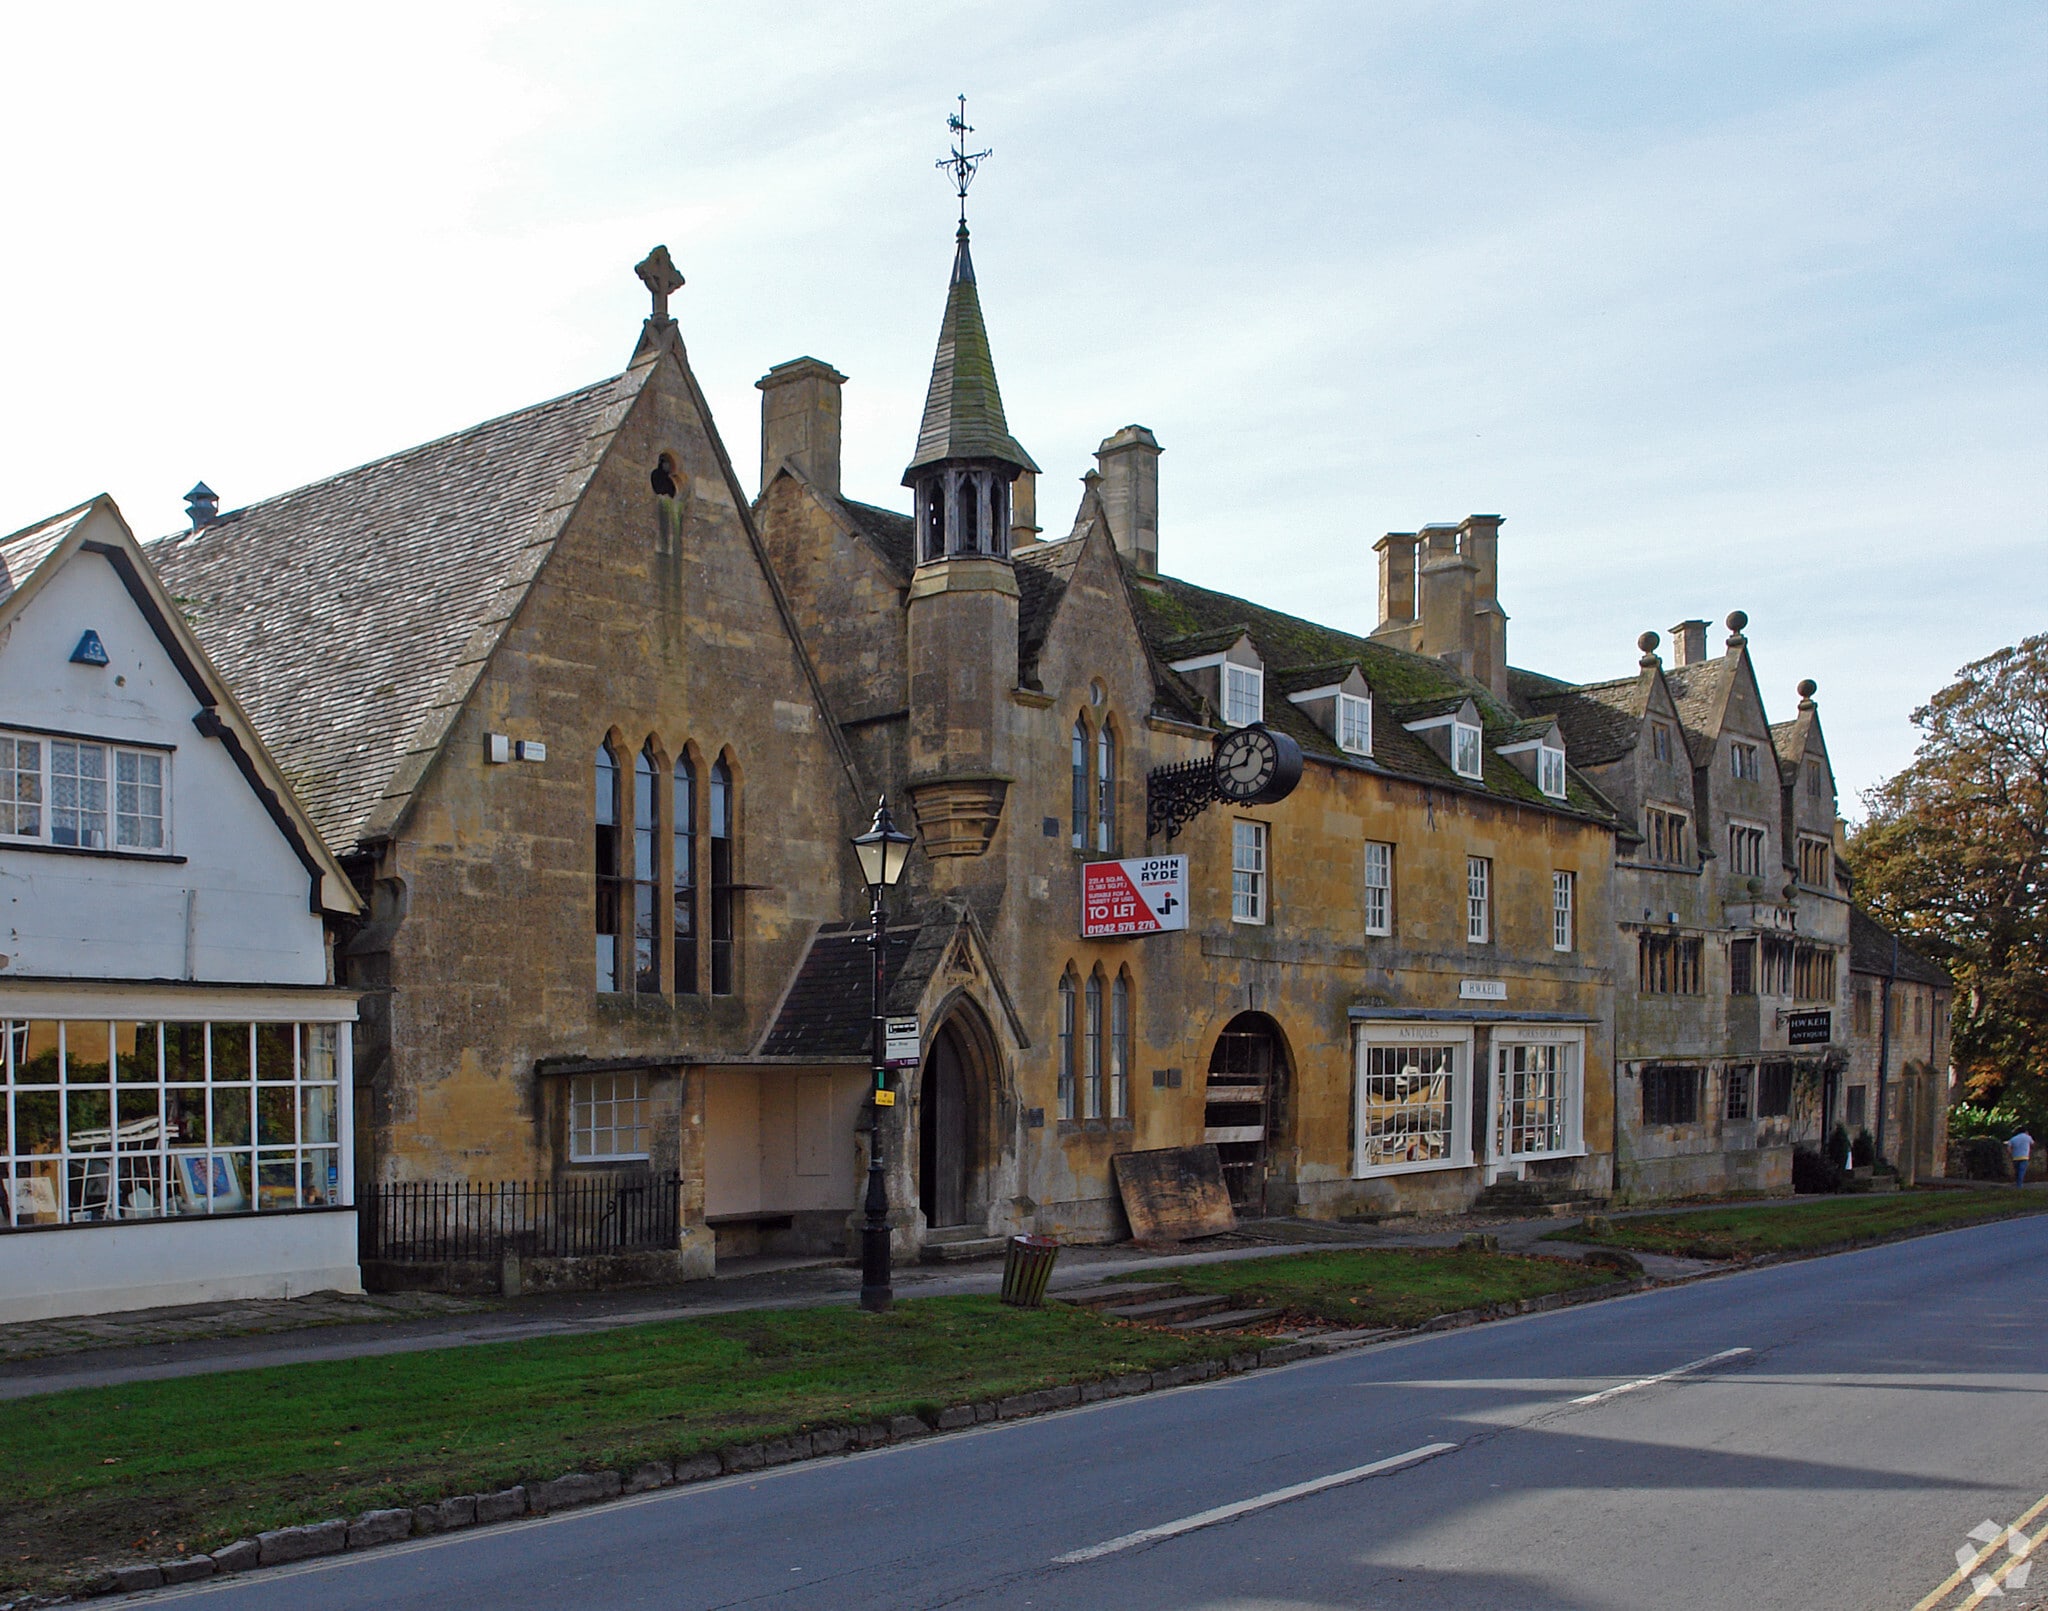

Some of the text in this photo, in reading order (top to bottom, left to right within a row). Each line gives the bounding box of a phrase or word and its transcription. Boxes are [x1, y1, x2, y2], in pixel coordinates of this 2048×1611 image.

[1141, 859, 1179, 871] JOHN
[1141, 870, 1179, 881] RYDE
[1088, 903, 1136, 920] TO LET
[1087, 919, 1156, 934] 01242 576 276
[1807, 1017, 1828, 1027] KEIL
[1399, 1026, 1440, 1039] ANTIQUES
[1516, 1028, 1539, 1039] WORKS
[1548, 1028, 1562, 1039] ART
[1792, 1031, 1828, 1039] ANTIQUES
